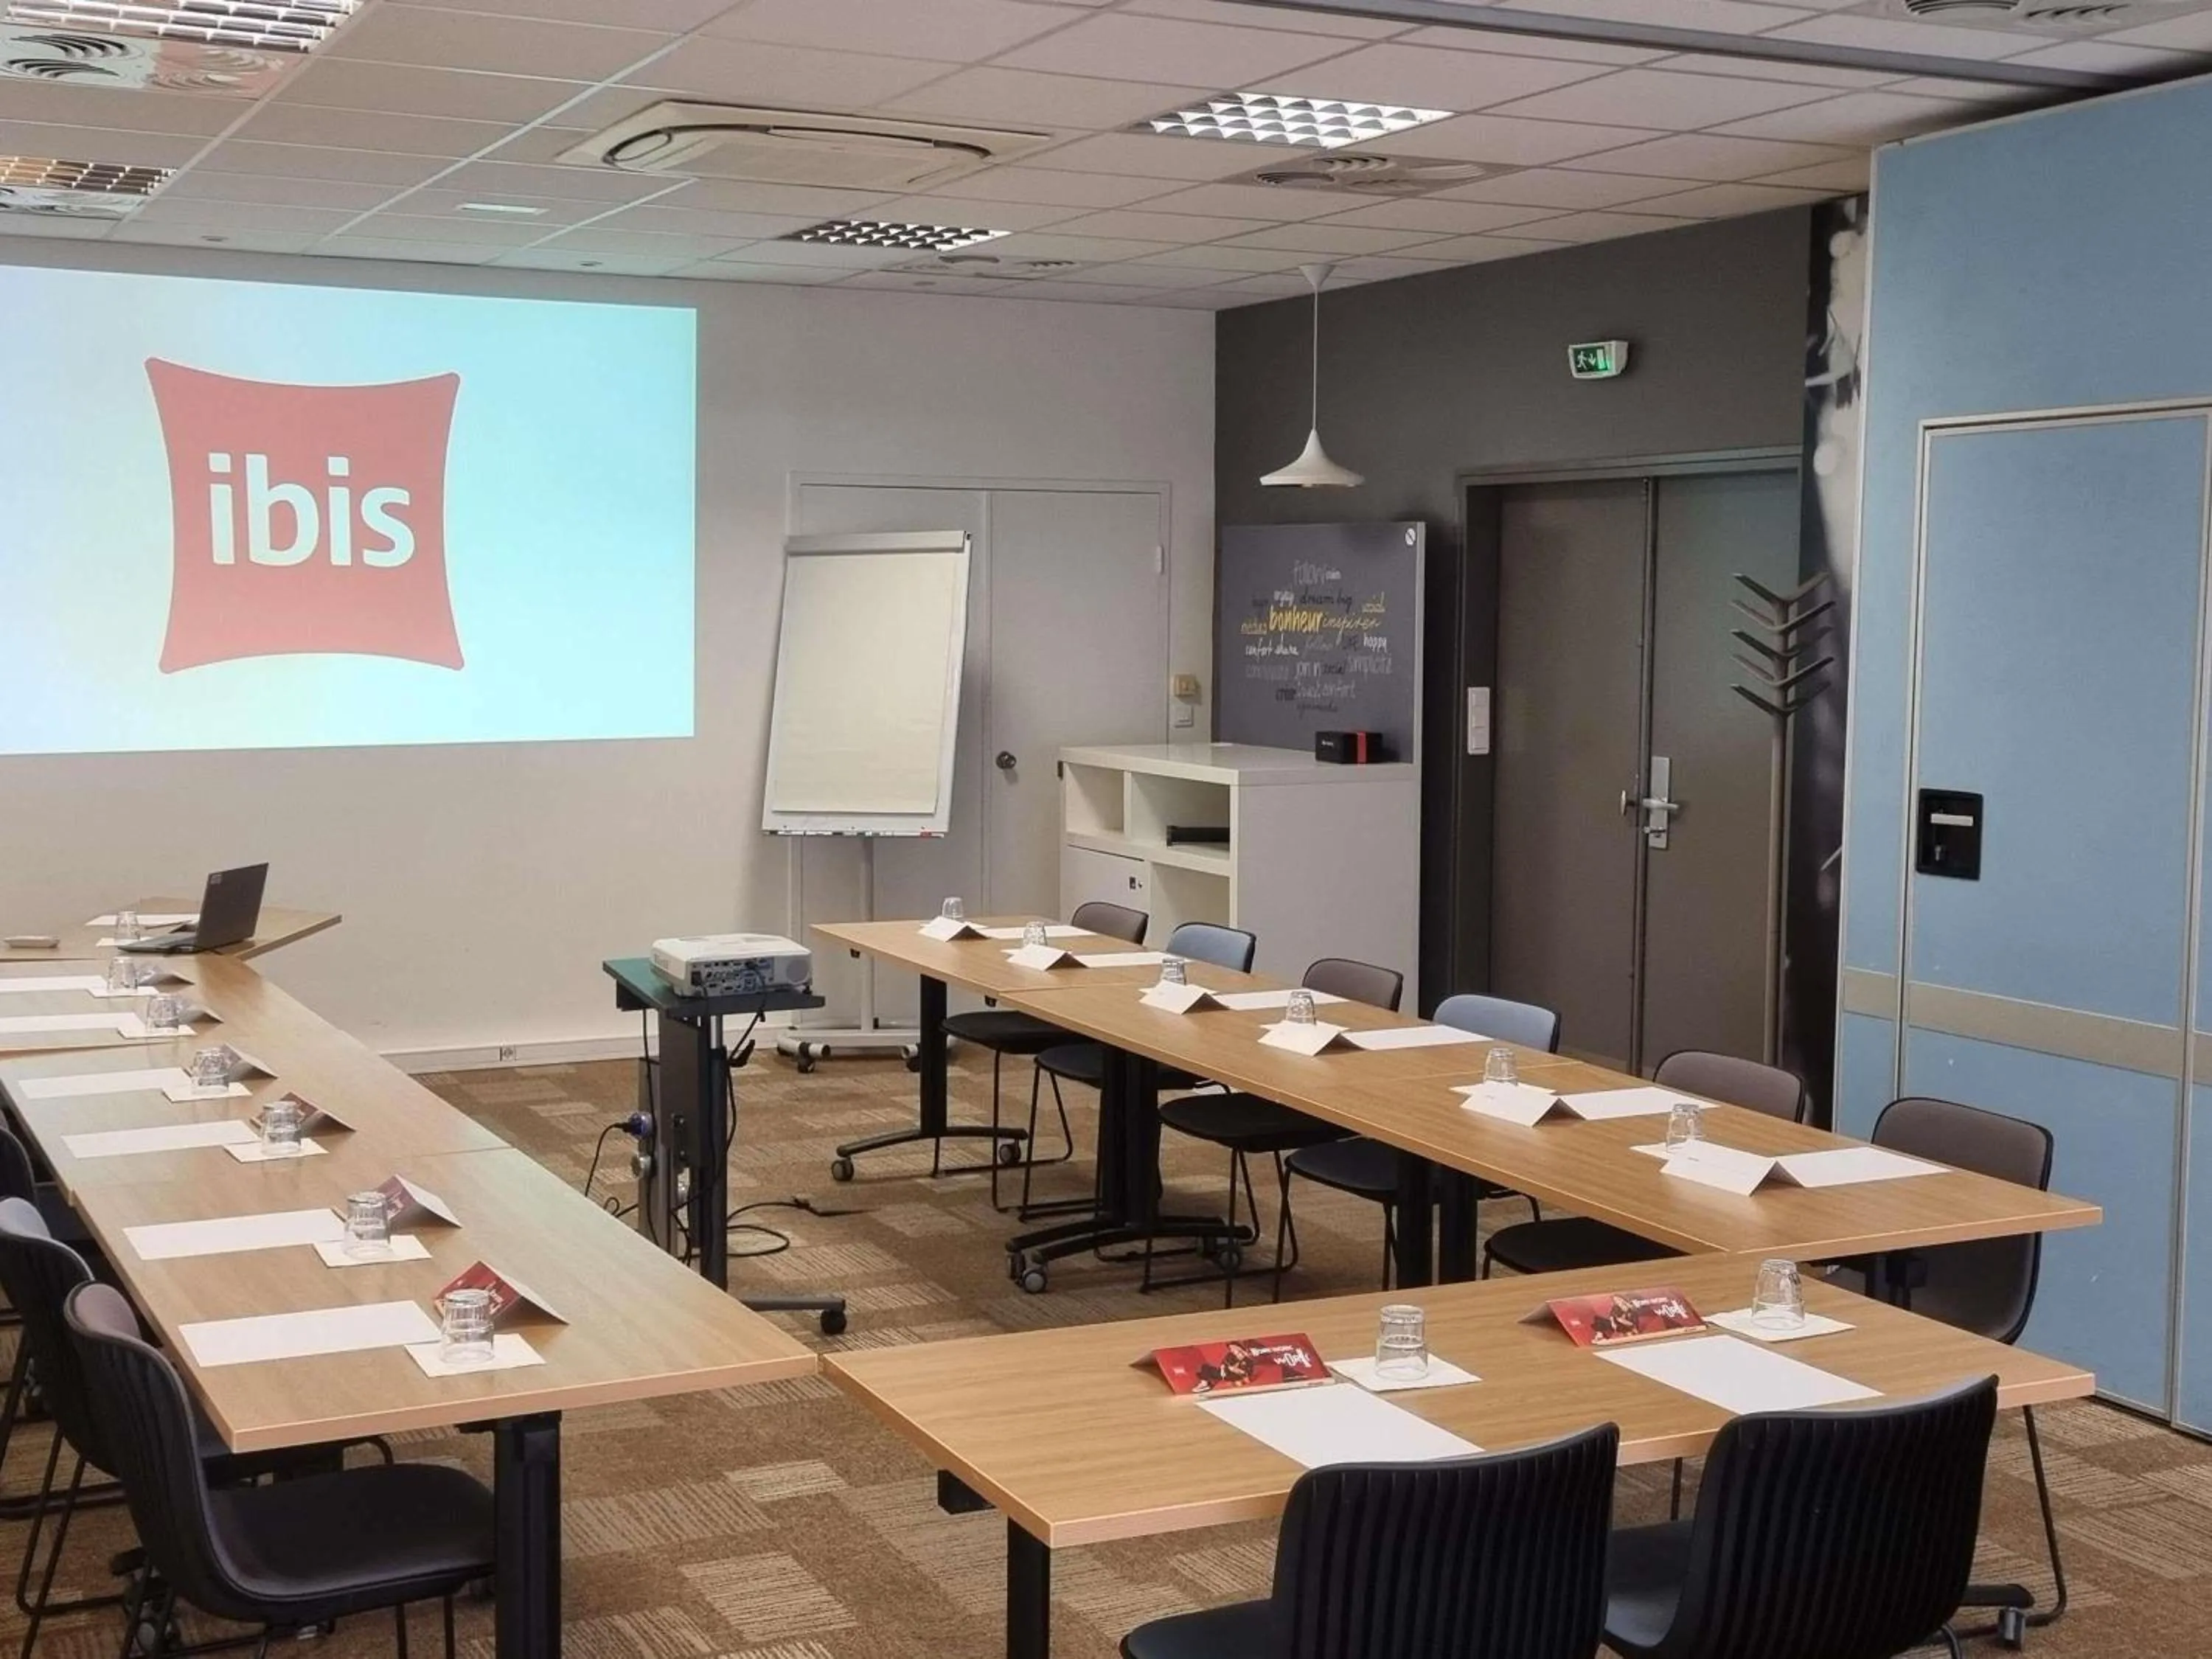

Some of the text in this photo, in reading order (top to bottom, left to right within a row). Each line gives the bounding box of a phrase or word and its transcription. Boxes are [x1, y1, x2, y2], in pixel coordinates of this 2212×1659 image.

[208, 452, 415, 568] ibis
[1269, 604, 1324, 634] bonheur
[1363, 632, 1388, 653] happy
